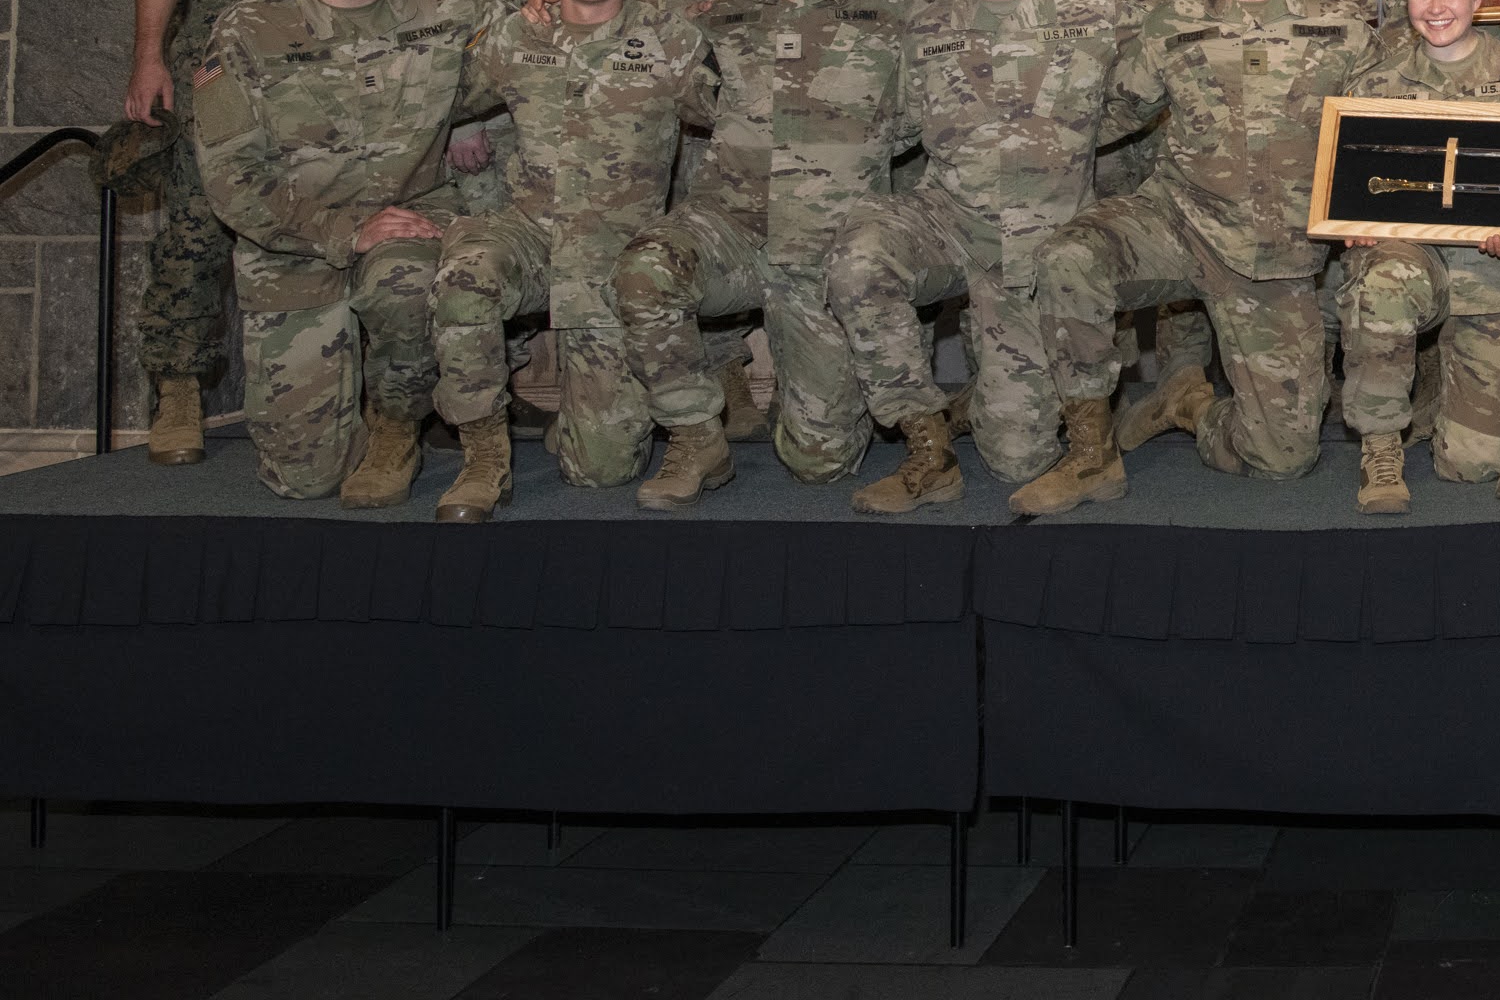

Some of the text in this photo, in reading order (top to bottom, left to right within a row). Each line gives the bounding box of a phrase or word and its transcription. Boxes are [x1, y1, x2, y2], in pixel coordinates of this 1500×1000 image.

[923, 40, 966, 56] HEMMINGER
[287, 51, 312, 63] MIMS
[521, 53, 557, 65] HALUSKA
